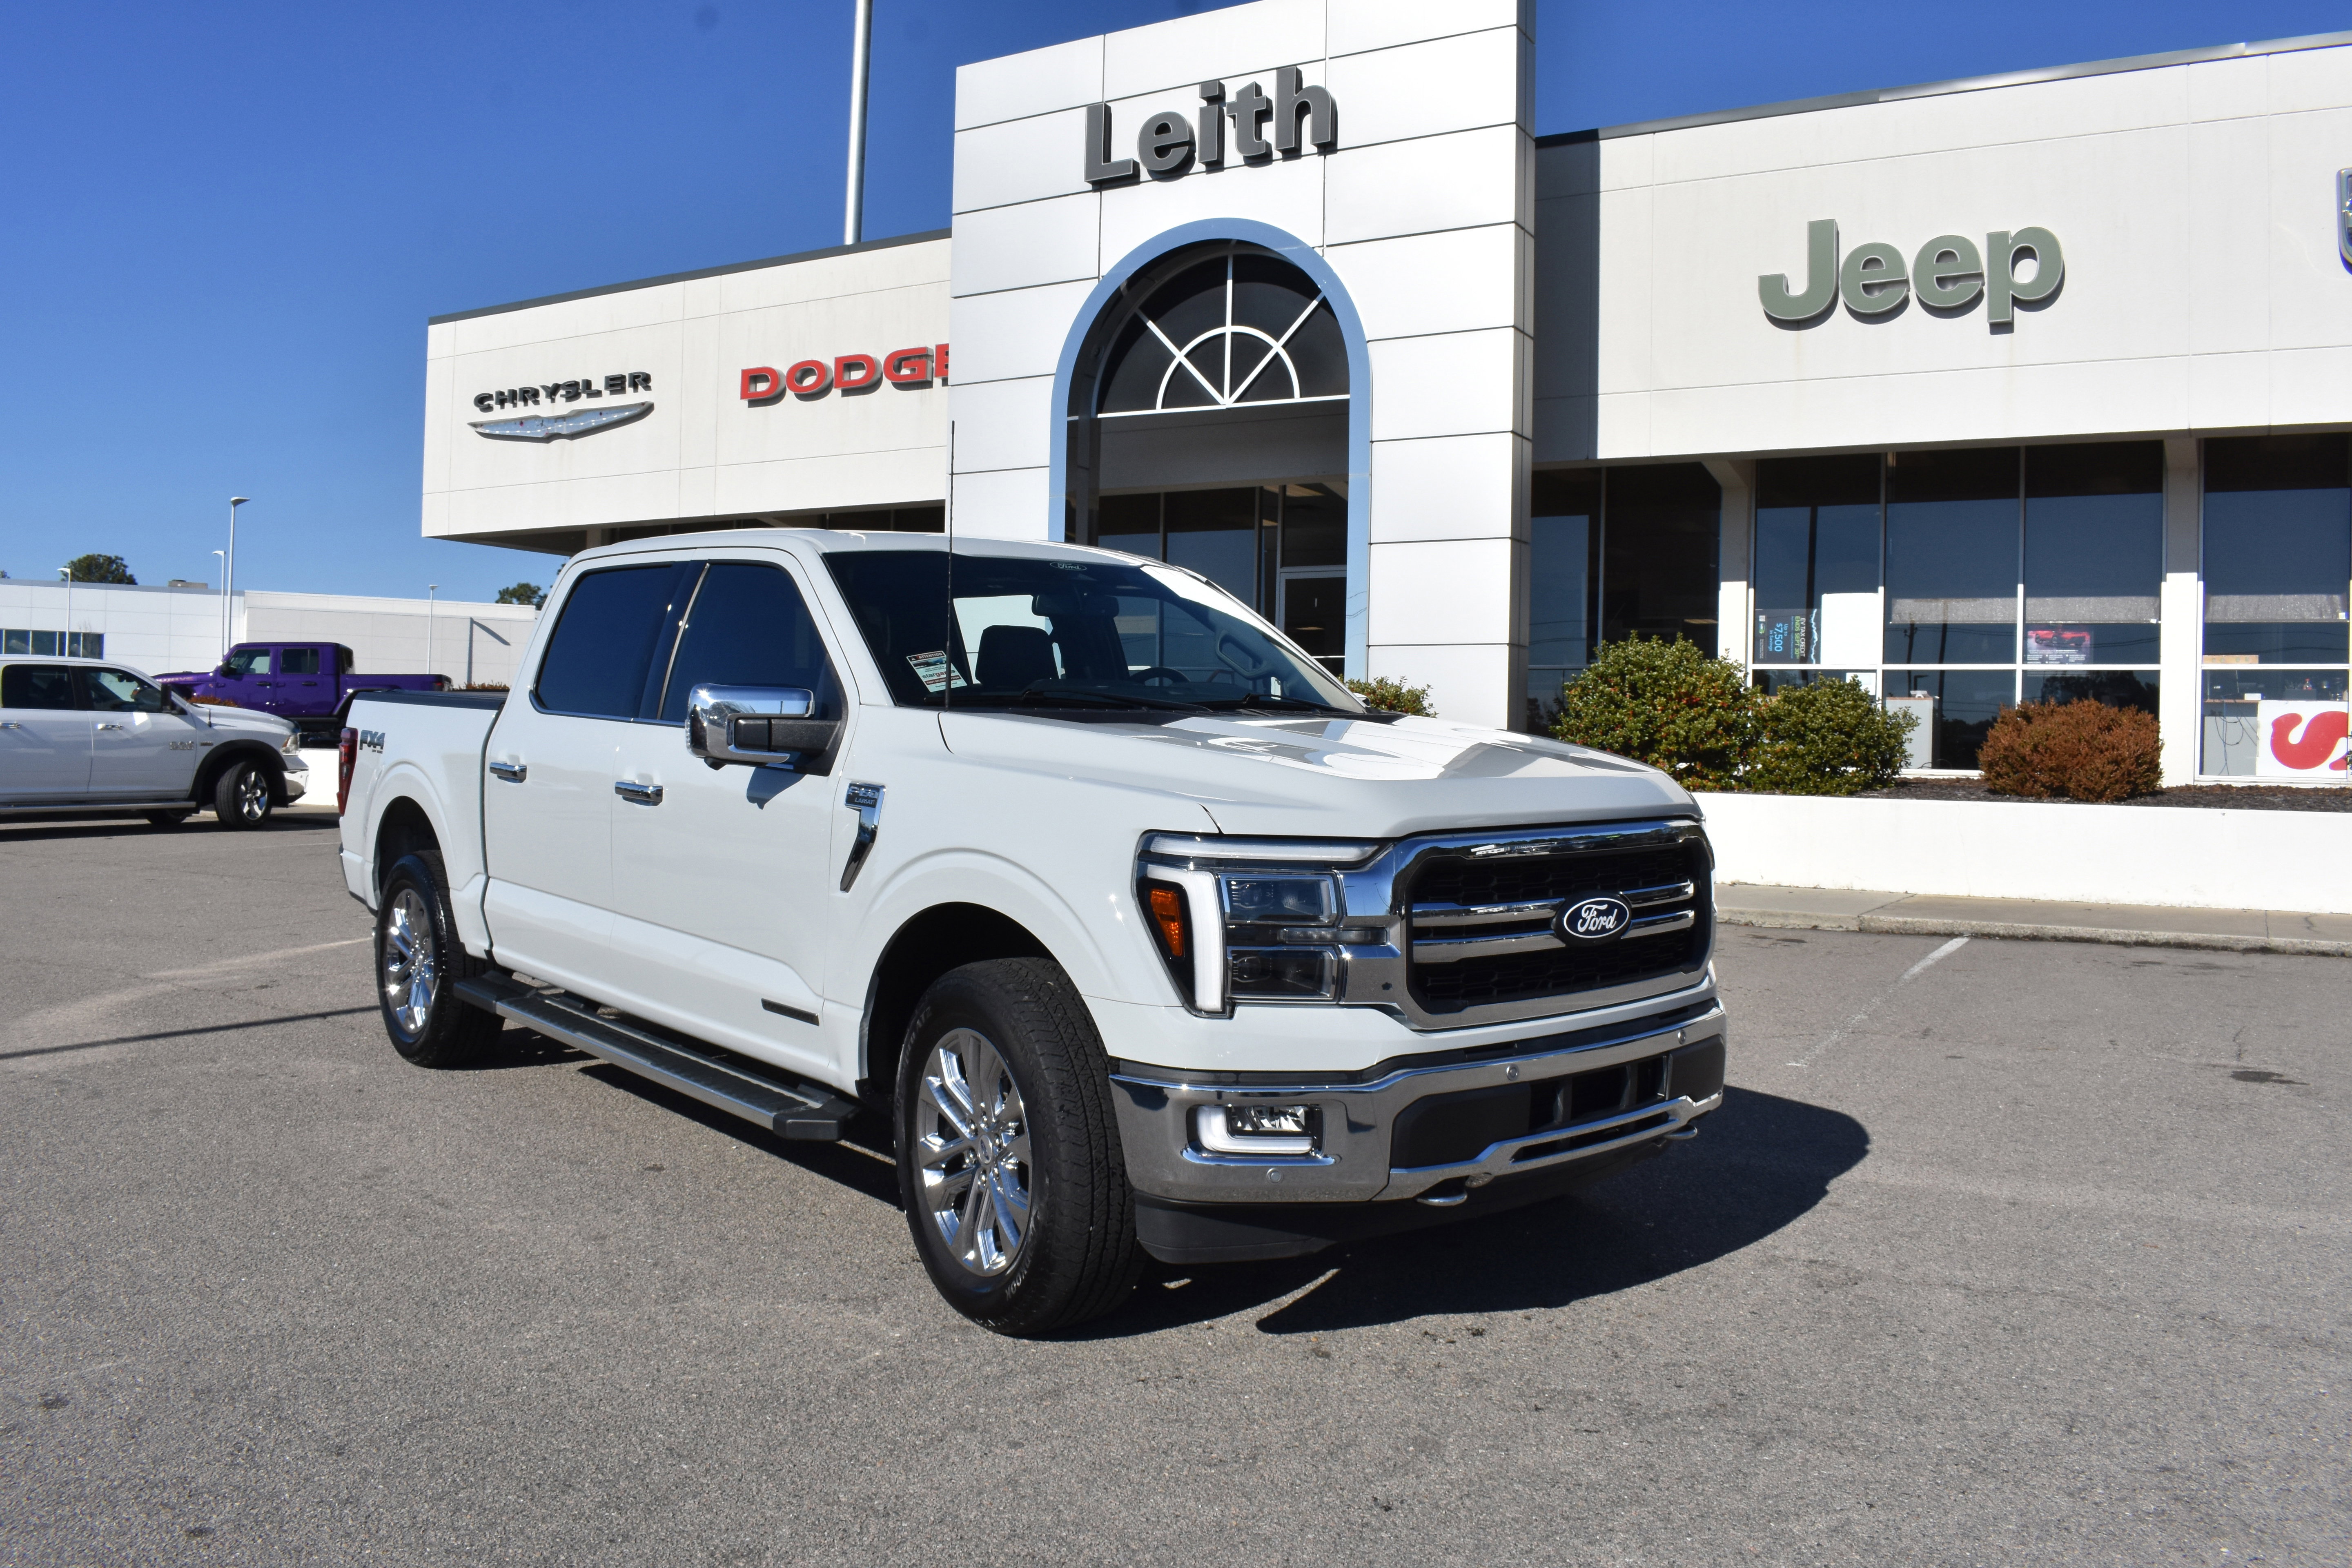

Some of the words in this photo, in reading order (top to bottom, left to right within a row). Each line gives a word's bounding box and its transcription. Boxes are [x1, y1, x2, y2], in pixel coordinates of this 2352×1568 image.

[1084, 66, 1337, 186] Leith
[1758, 218, 2065, 325] Jeep
[474, 371, 652, 412] CHRYSLER
[1774, 623, 1783, 652] $7,500
[359, 729, 385, 750] FX4
[1577, 903, 1617, 933] Ford
